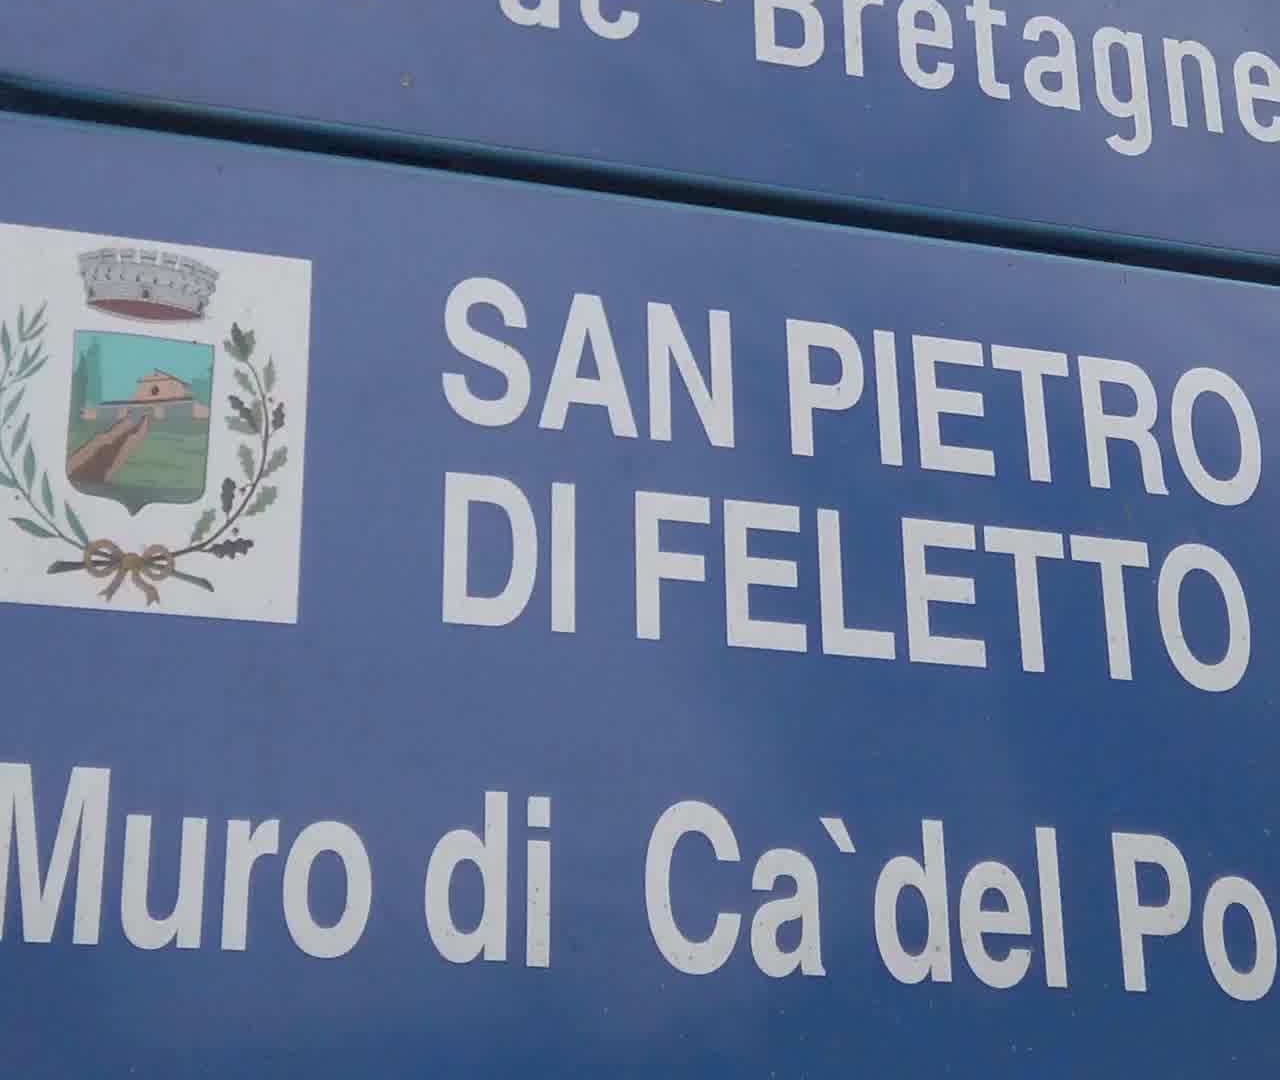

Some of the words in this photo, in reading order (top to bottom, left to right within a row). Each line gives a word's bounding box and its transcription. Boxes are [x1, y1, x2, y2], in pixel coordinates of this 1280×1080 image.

[441, 276, 736, 449] SAN
[786, 317, 1262, 506] PIETRO
[441, 472, 577, 633] DI
[634, 489, 1251, 692] FELETTO
[425, 791, 553, 968] di
